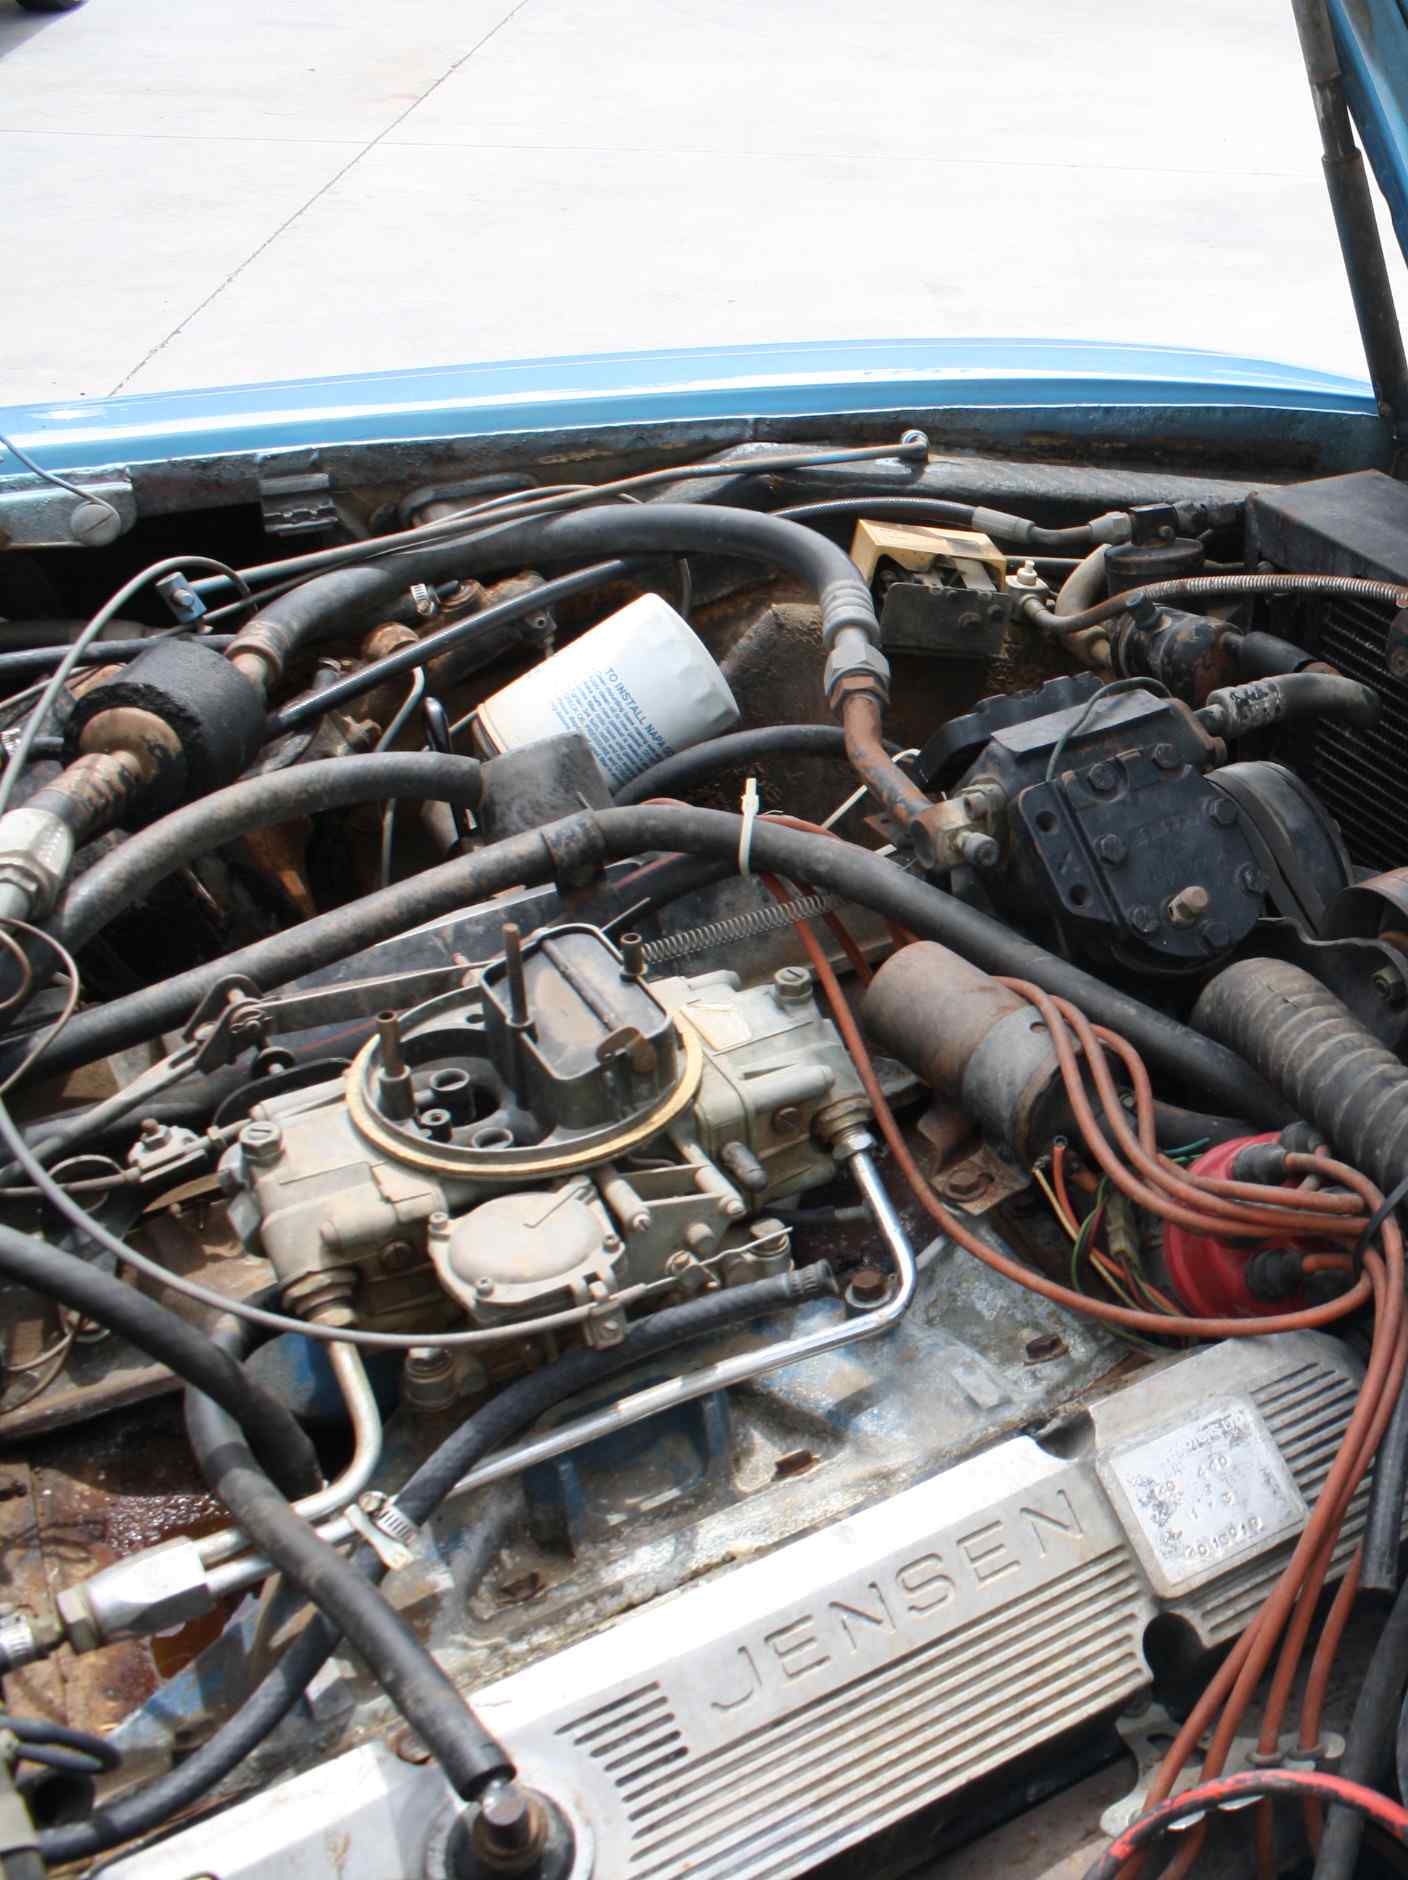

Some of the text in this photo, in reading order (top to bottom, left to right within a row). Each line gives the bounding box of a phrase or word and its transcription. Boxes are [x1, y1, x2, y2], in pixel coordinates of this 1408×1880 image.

[607, 667, 667, 748] TO INSTALL NAPA
[711, 1488, 1084, 1710] JENSEN
